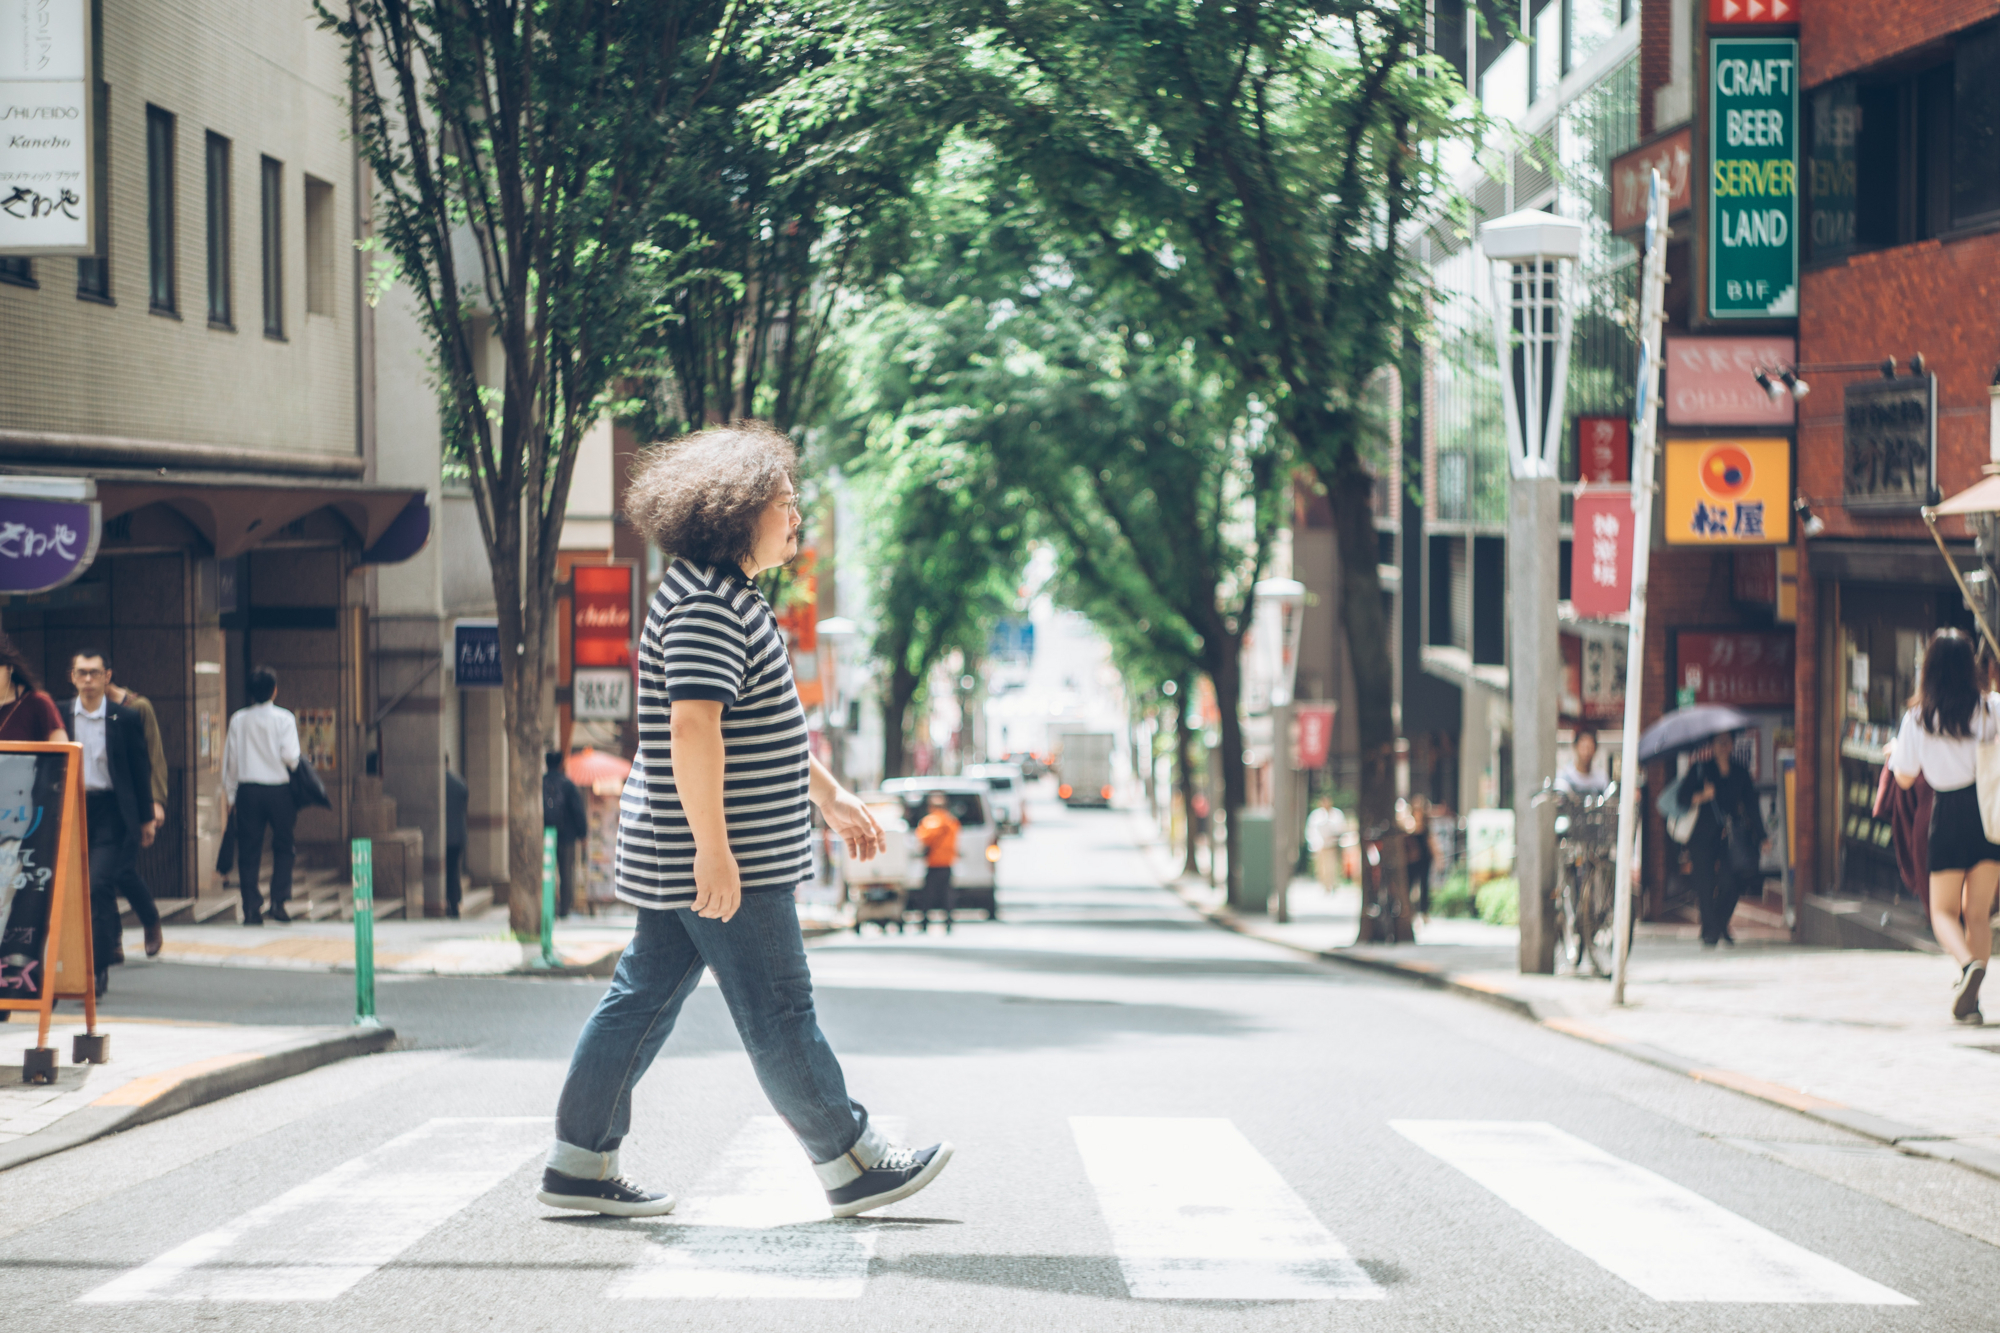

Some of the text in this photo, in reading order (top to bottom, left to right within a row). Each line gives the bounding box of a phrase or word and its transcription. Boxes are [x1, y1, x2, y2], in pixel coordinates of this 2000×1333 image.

[1717, 58, 1793, 96] CRAFT
[0, 106, 79, 120] SHISEIDO
[1726, 109, 1784, 147] BEER
[1713, 159, 1796, 197] SERVER
[1722, 208, 1788, 248] LAND
[1691, 499, 1766, 539] 松屋
